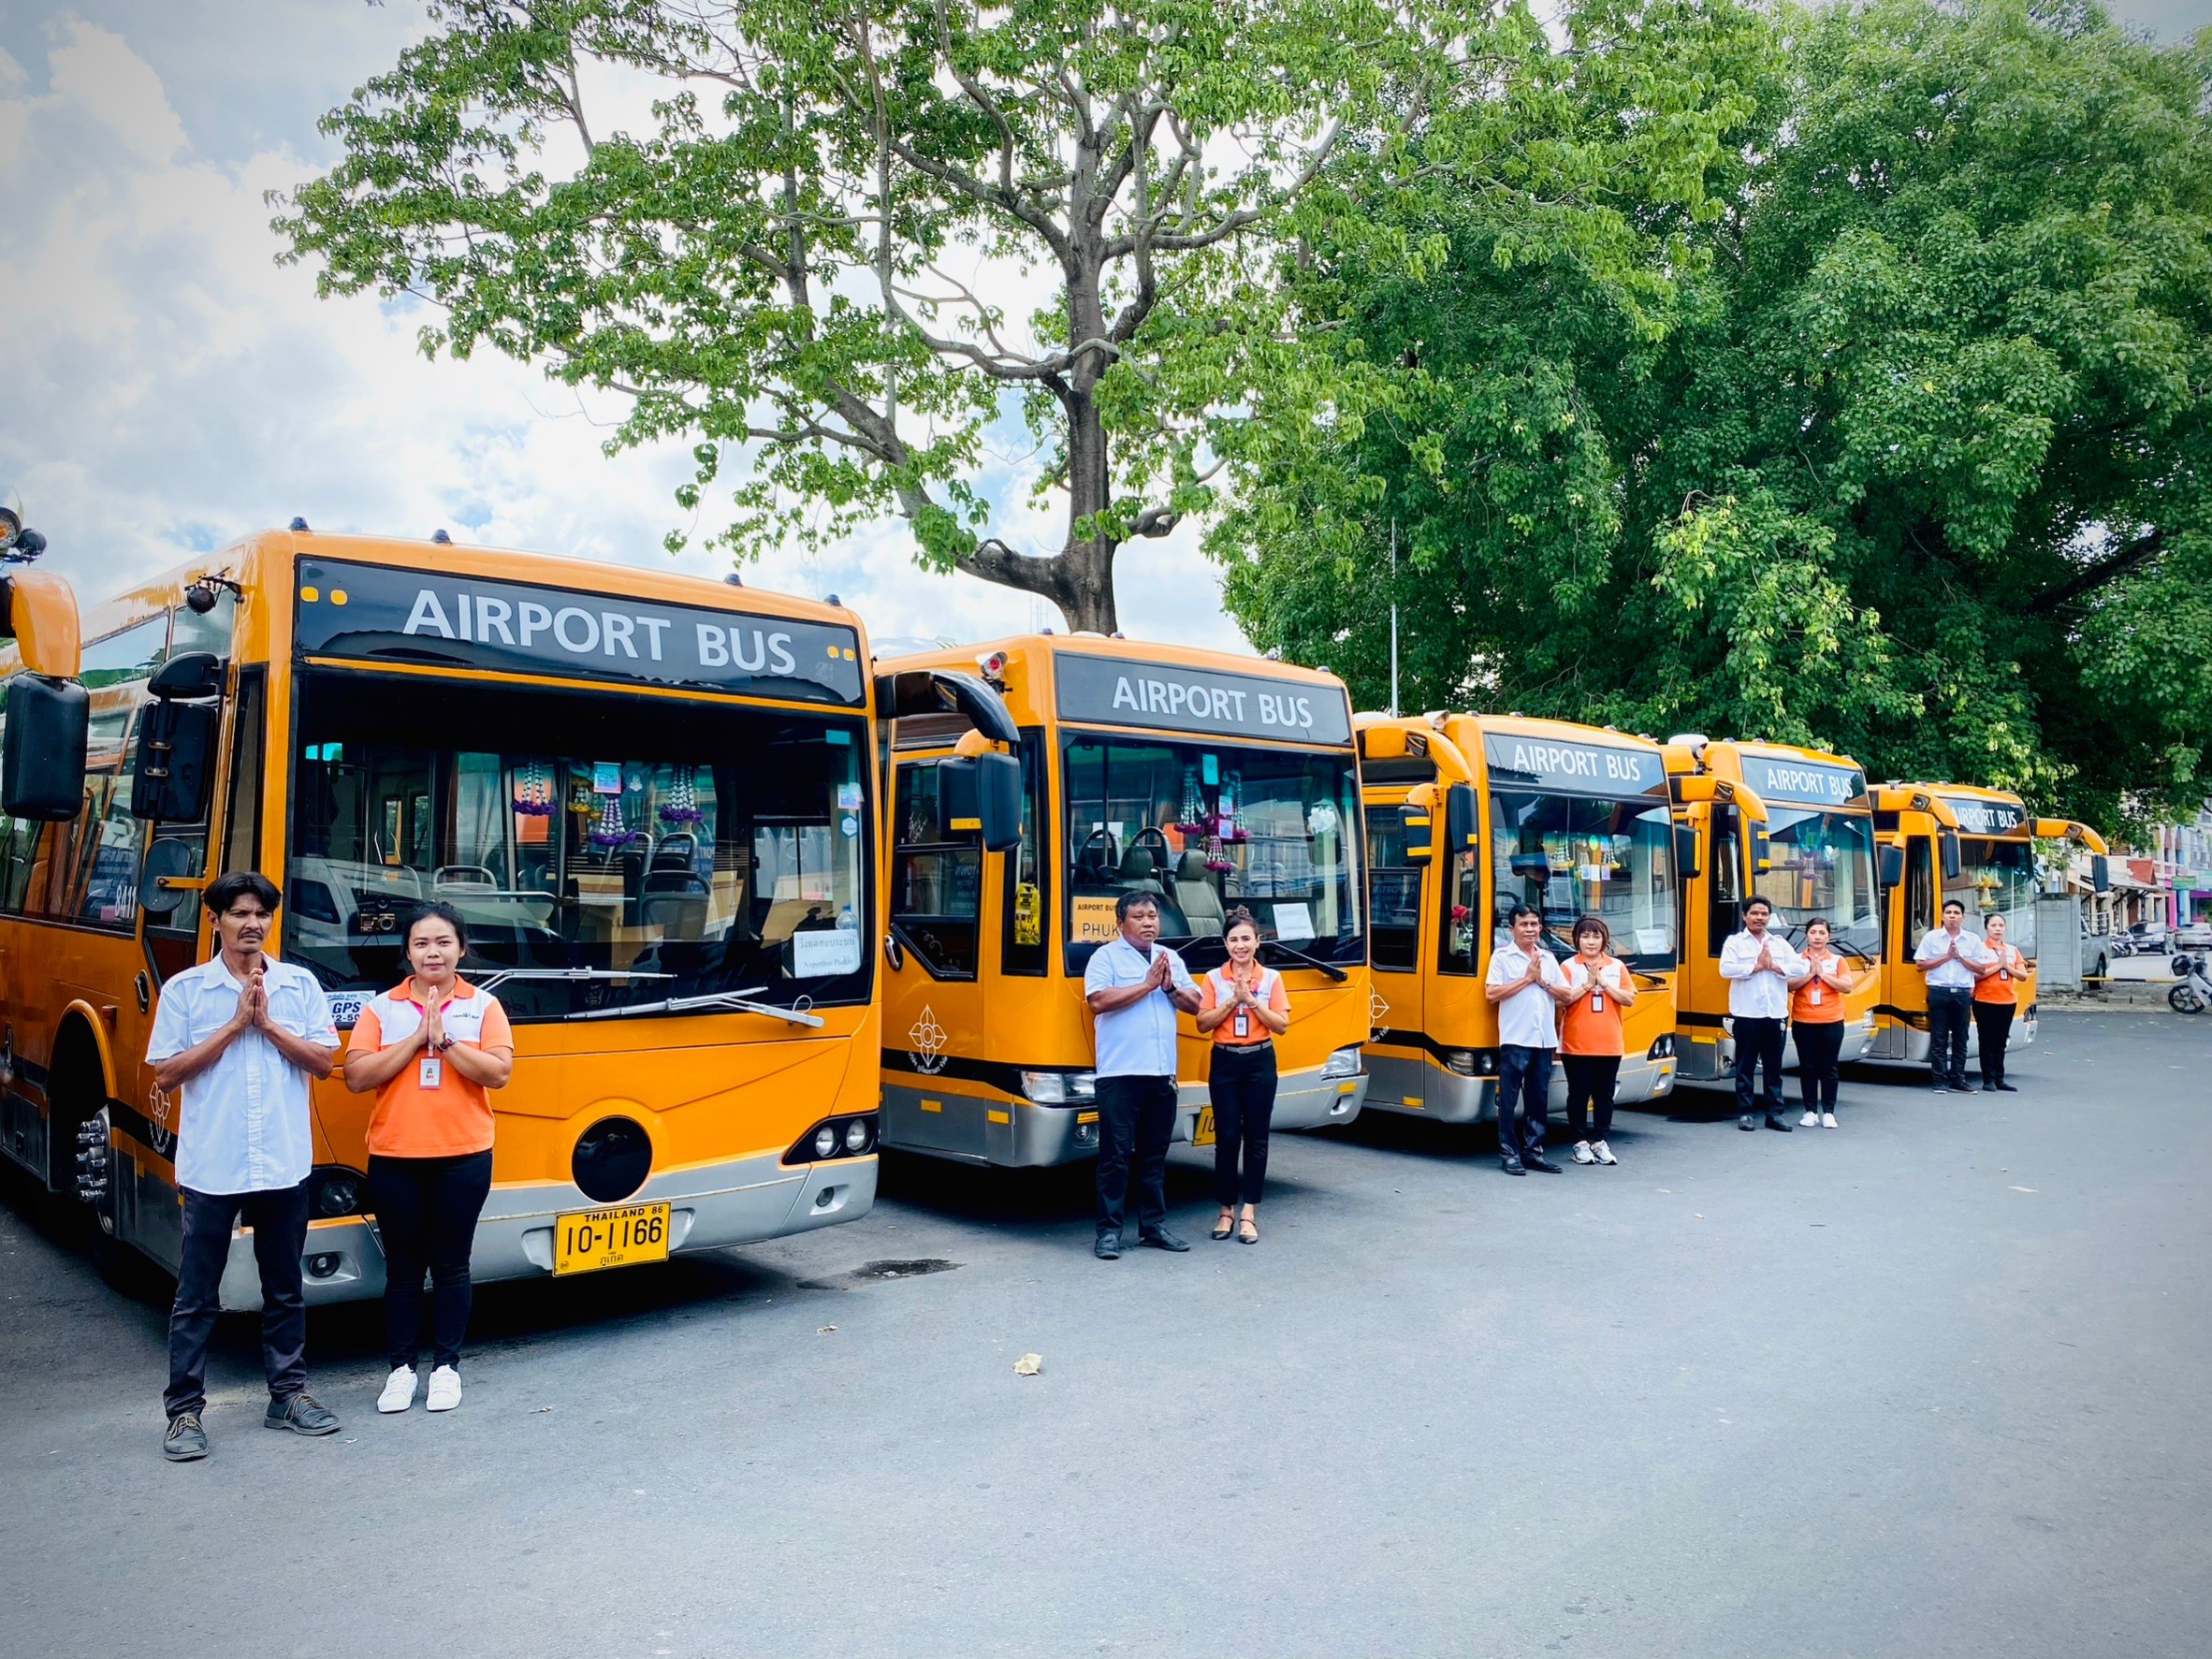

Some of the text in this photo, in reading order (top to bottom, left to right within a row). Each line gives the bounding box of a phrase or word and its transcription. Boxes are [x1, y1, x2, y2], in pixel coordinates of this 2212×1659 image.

[402, 589, 796, 675] AIRPORT BUS
[1112, 676, 1313, 728] AIRPORT BUS
[1513, 744, 1641, 781] AIRPORT BUS
[1768, 768, 1854, 798] AIRPORT BUS
[1952, 807, 2017, 829] AIRPORT BUS
[114, 884, 137, 919] 8411
[332, 1001, 361, 1014] GPS
[584, 1205, 663, 1223] THAILAND 86
[566, 1215, 662, 1256] 10-1166
